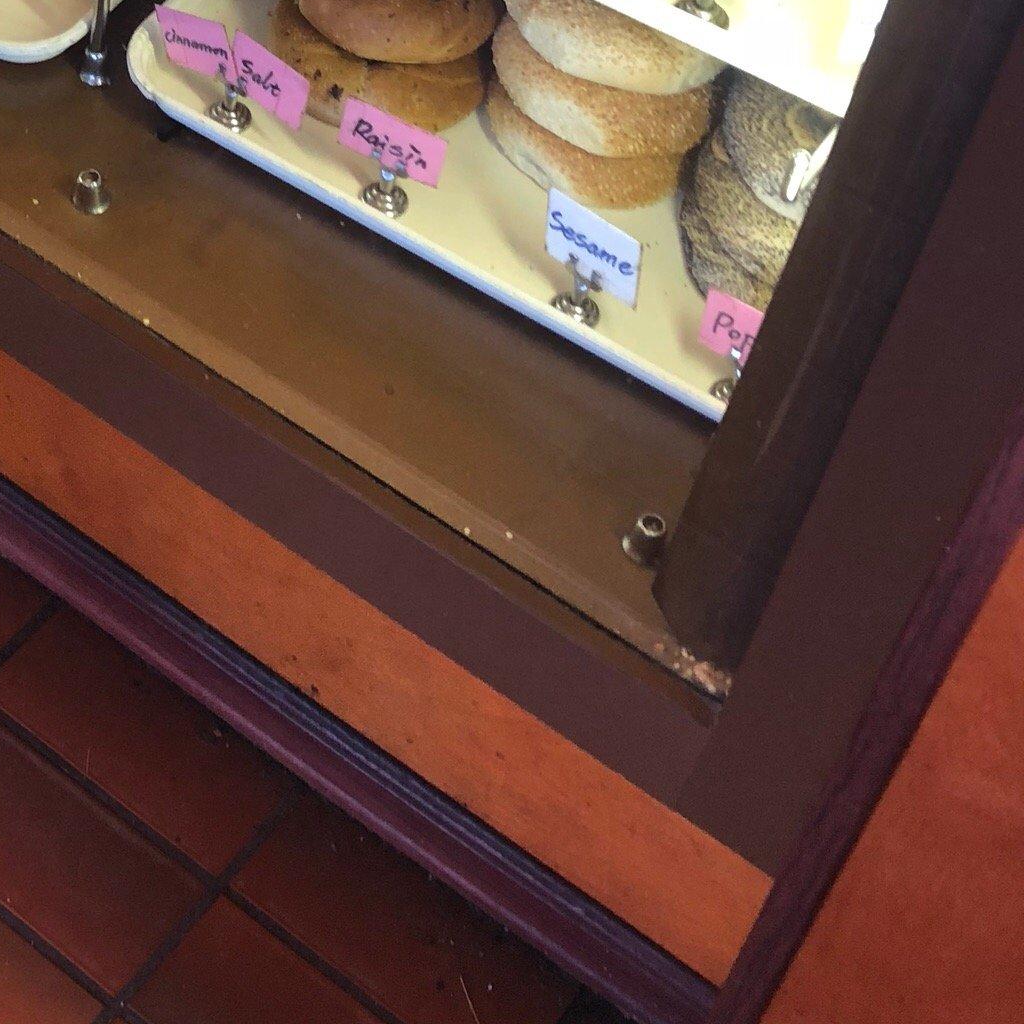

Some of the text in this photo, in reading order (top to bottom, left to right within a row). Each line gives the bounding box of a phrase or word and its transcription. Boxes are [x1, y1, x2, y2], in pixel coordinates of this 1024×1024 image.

[241, 59, 281, 97] Salt
[352, 118, 427, 170] Raisin
[549, 210, 634, 276] Sesame
